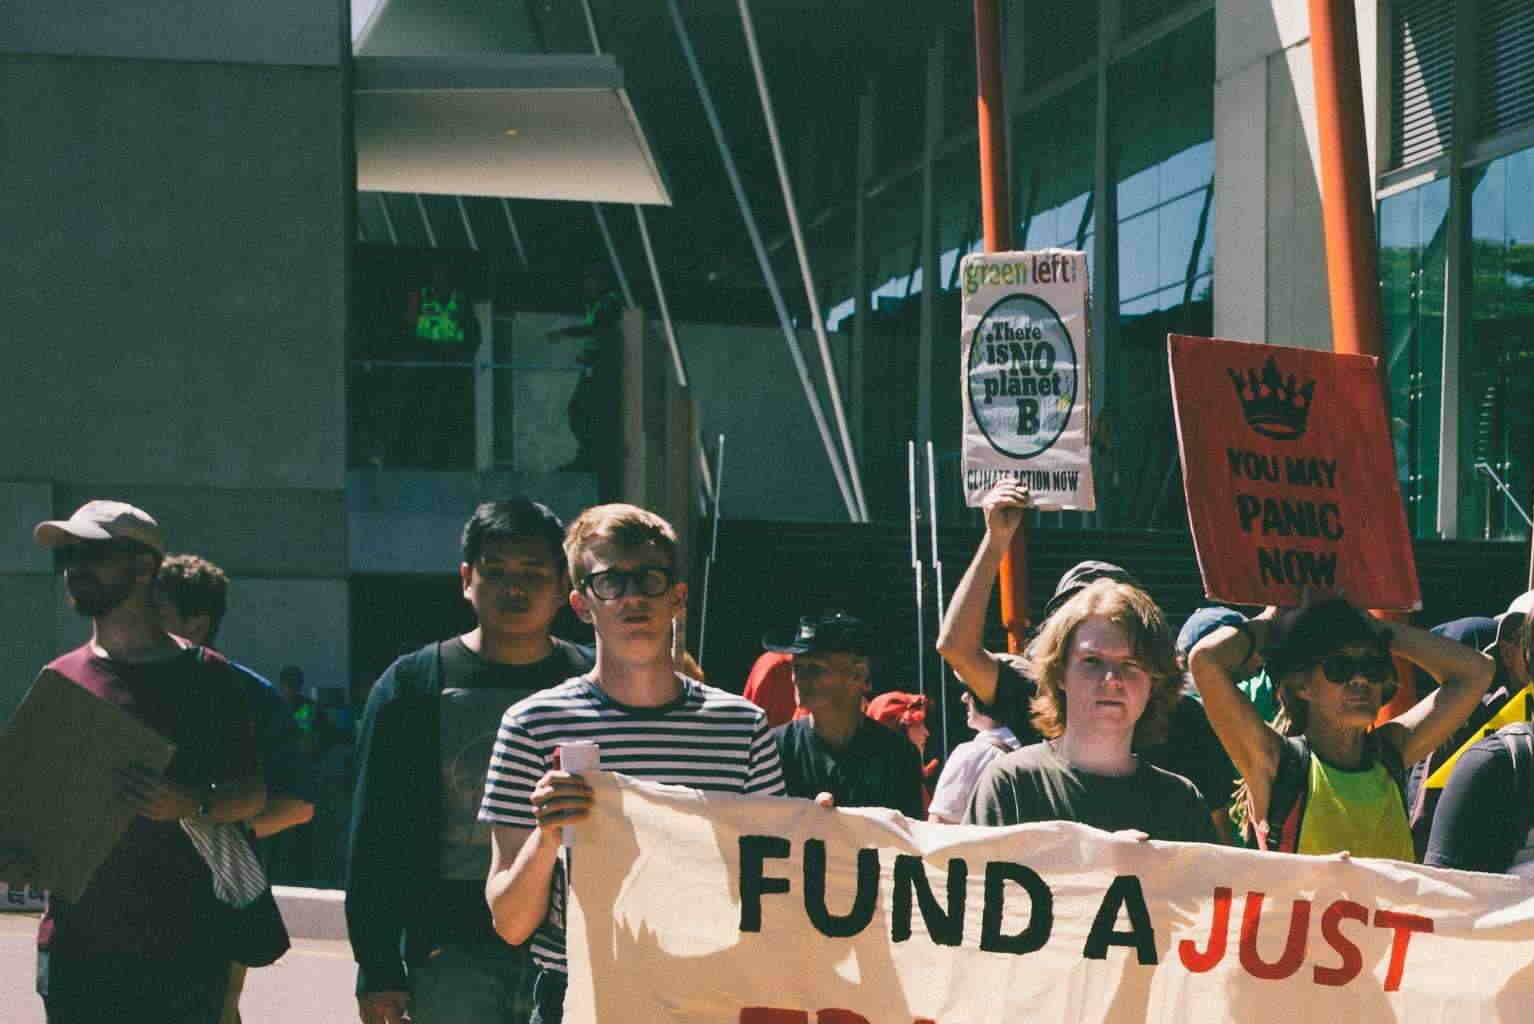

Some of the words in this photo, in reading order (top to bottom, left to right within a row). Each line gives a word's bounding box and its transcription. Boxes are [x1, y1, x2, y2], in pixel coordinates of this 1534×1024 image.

[965, 262, 1026, 294] green
[991, 321, 1041, 341] There
[985, 332, 1009, 365] is
[1009, 341, 1056, 376] NO
[984, 369, 1060, 404] planet
[1016, 398, 1041, 436] B
[1052, 470, 1080, 492] NOW
[1227, 448, 1279, 483] YOU
[1284, 455, 1338, 488] MAY
[1236, 495, 1344, 541] PANIC
[1256, 545, 1339, 588] NOW
[738, 835, 1053, 955] FUND
[1083, 875, 1158, 965] A
[1178, 886, 1435, 992] JUST
